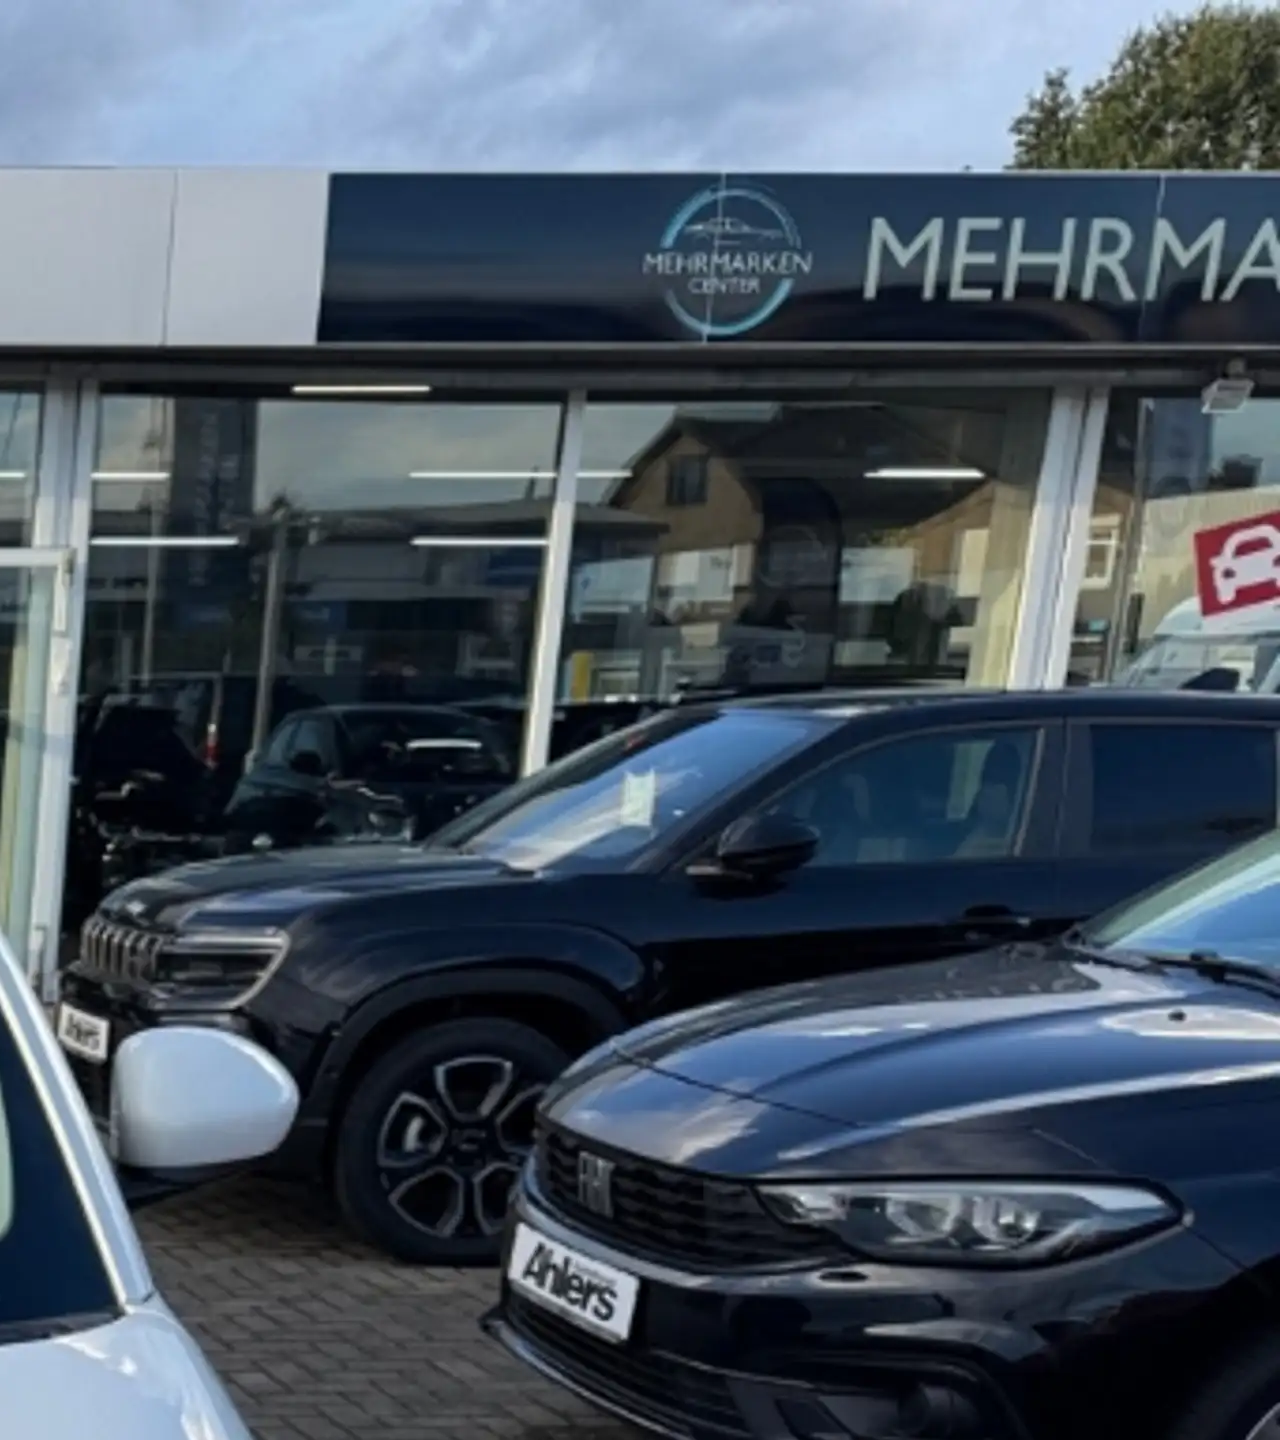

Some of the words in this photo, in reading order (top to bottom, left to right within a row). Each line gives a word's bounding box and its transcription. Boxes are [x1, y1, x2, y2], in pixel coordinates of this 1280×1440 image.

[642, 251, 813, 275] MEHRMARKEN
[688, 277, 761, 294] CENTER
[522, 1241, 619, 1321] Ahlers
